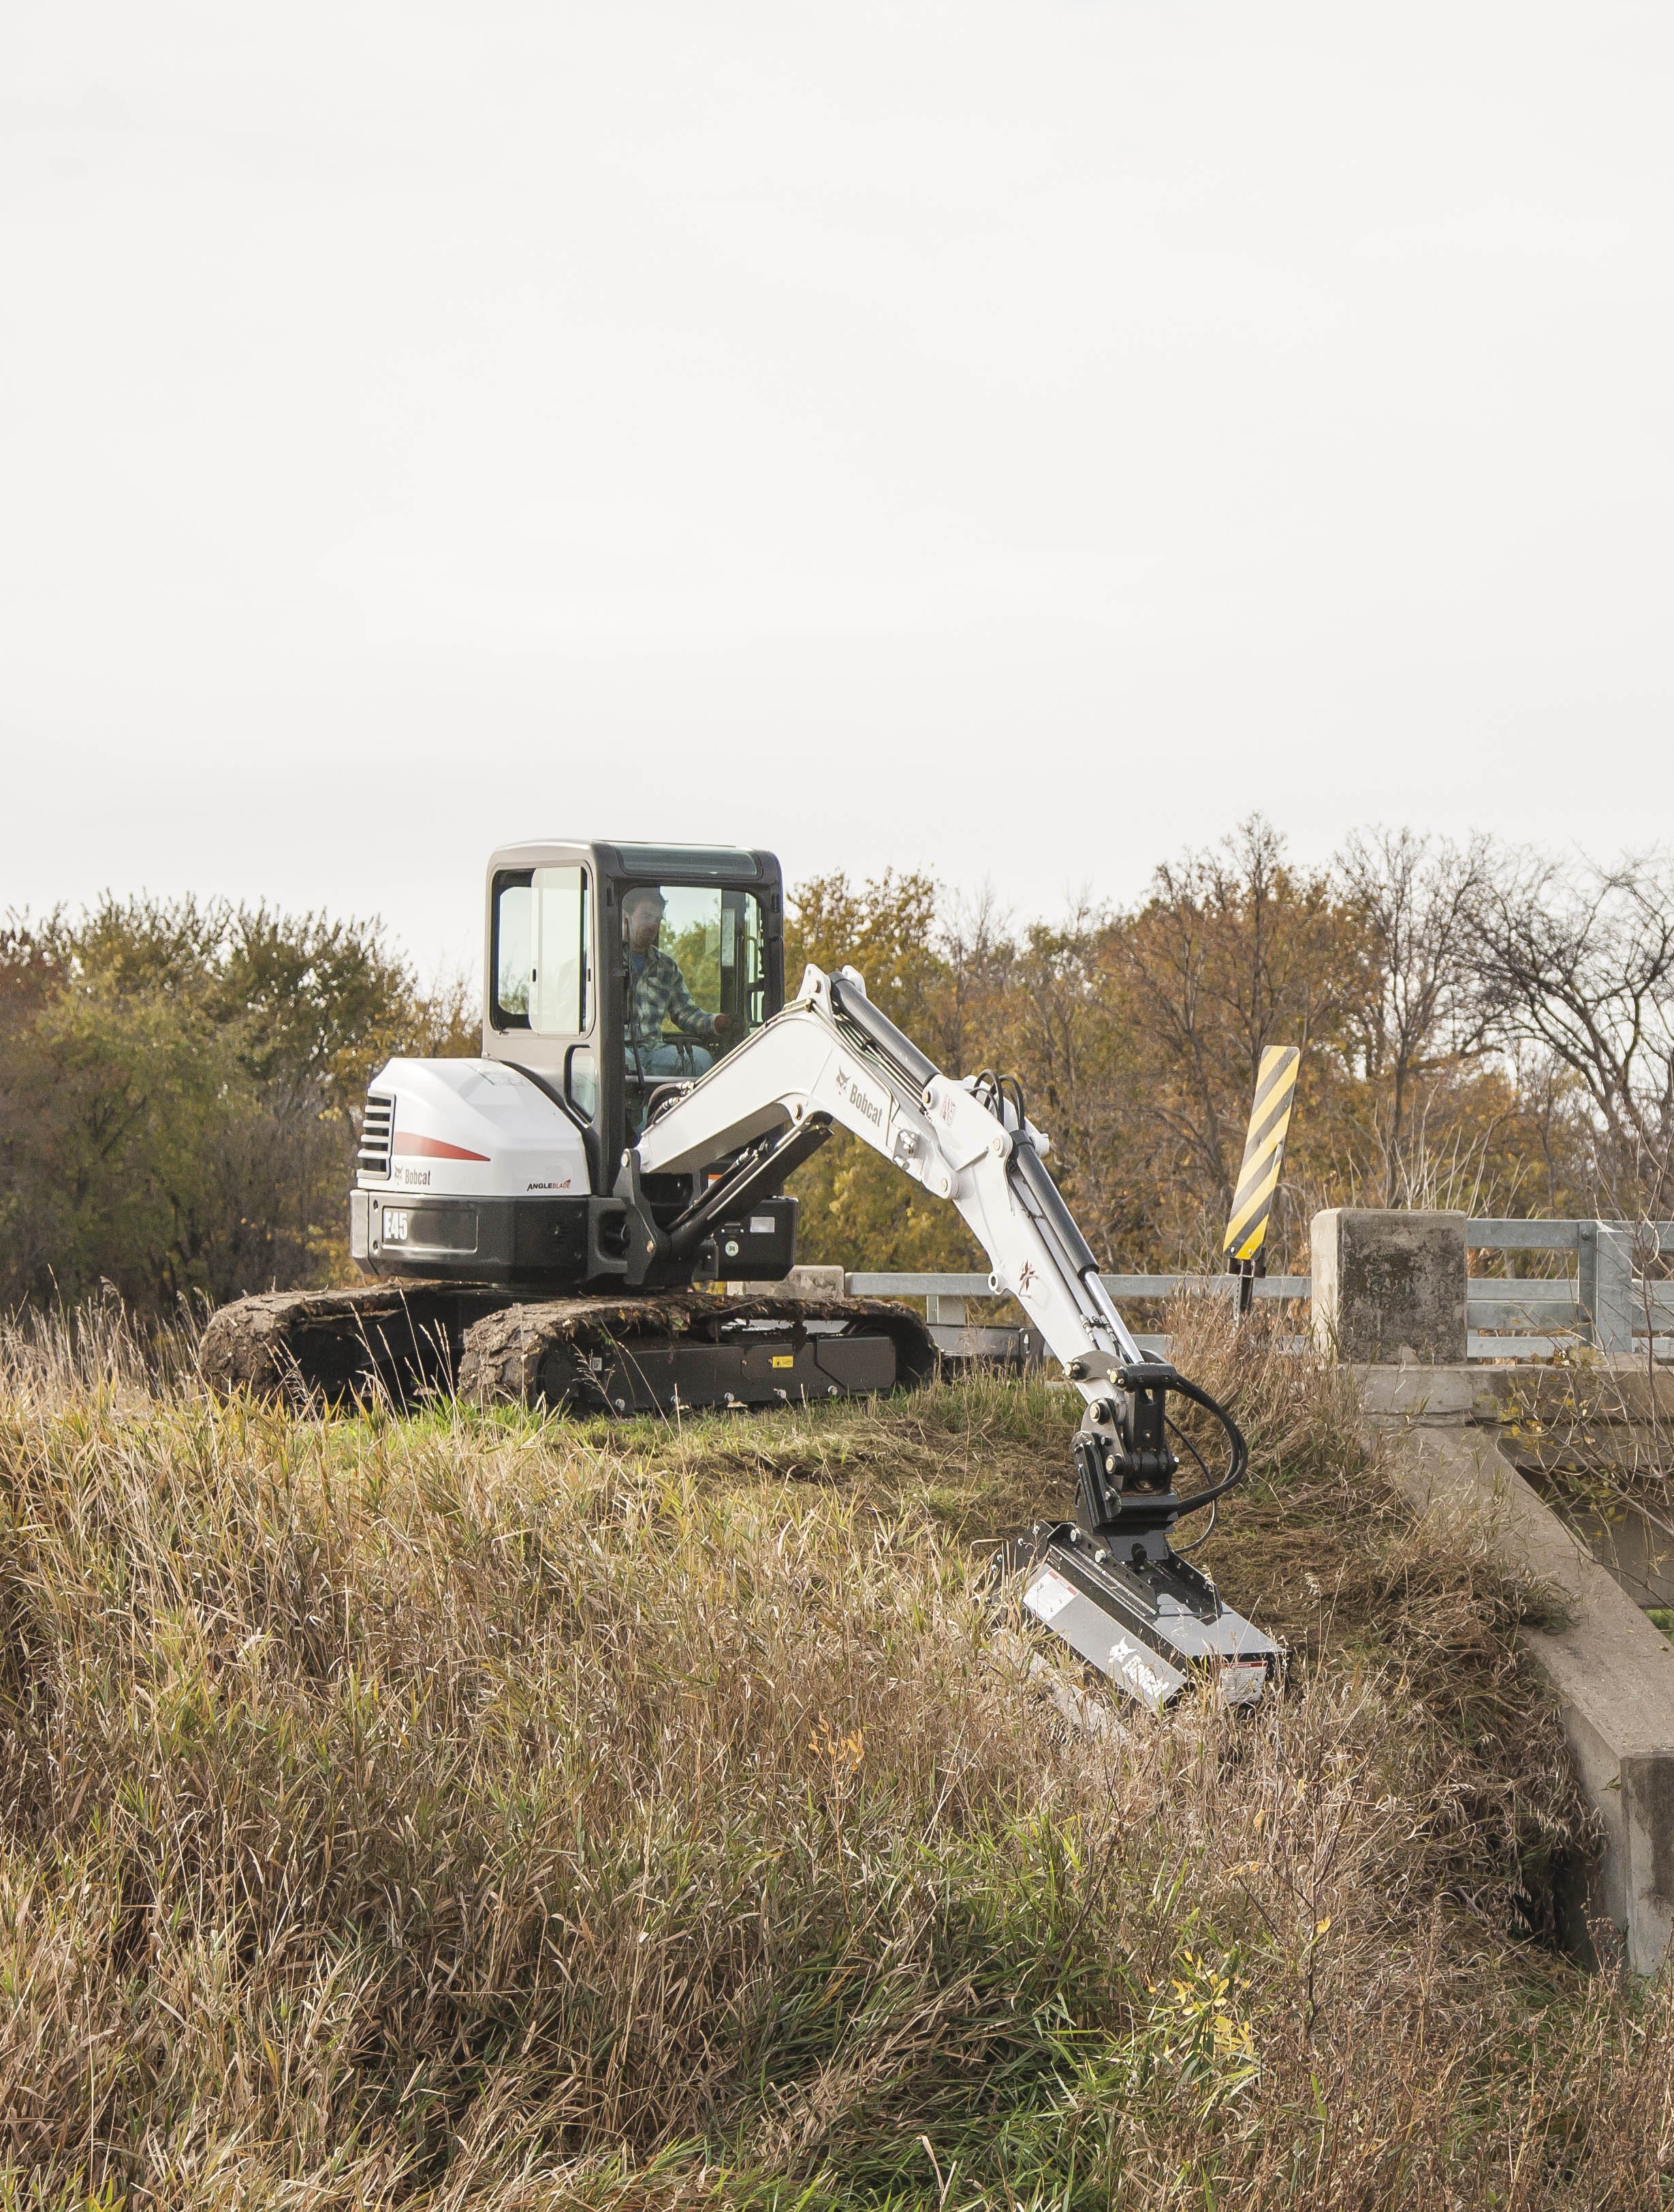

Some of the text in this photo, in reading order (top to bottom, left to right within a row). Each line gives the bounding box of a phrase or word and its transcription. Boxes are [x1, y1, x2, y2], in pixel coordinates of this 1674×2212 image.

[850, 1084, 883, 1127] Bobcat
[405, 1169, 430, 1186] Bobcat
[384, 1212, 407, 1240] E45
